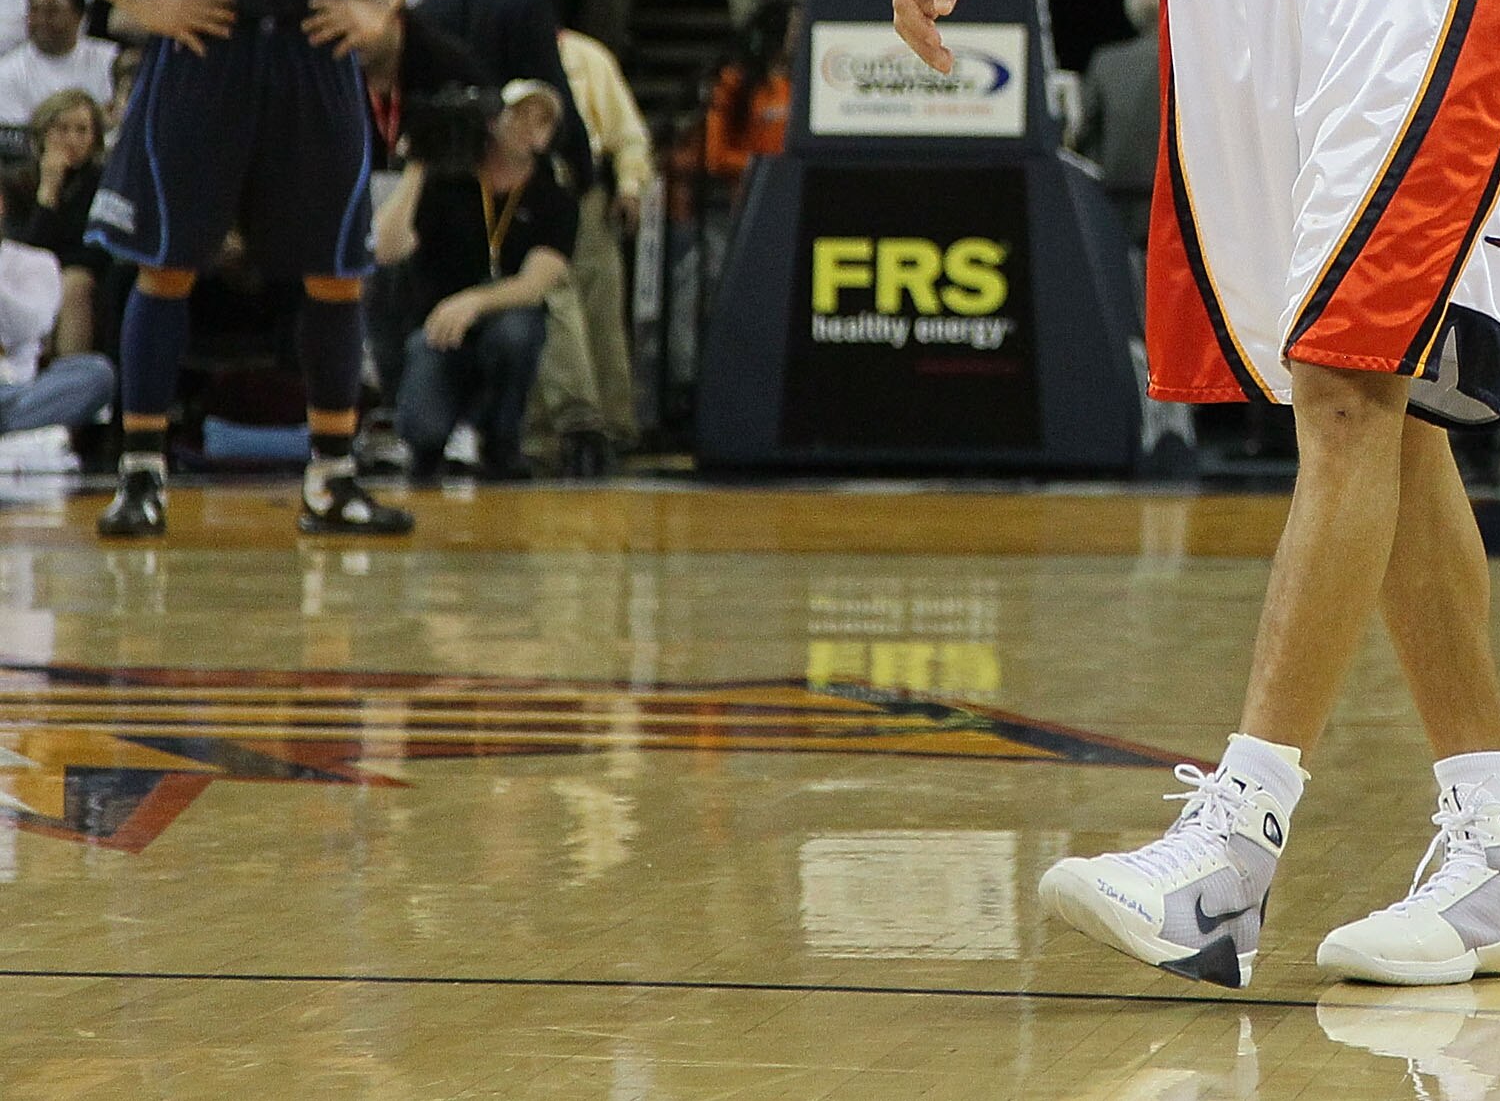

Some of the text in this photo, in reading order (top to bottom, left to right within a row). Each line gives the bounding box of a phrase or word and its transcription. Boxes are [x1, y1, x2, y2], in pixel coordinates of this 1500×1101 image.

[812, 236, 1009, 315] FRS
[812, 311, 1009, 350] healthy energy
